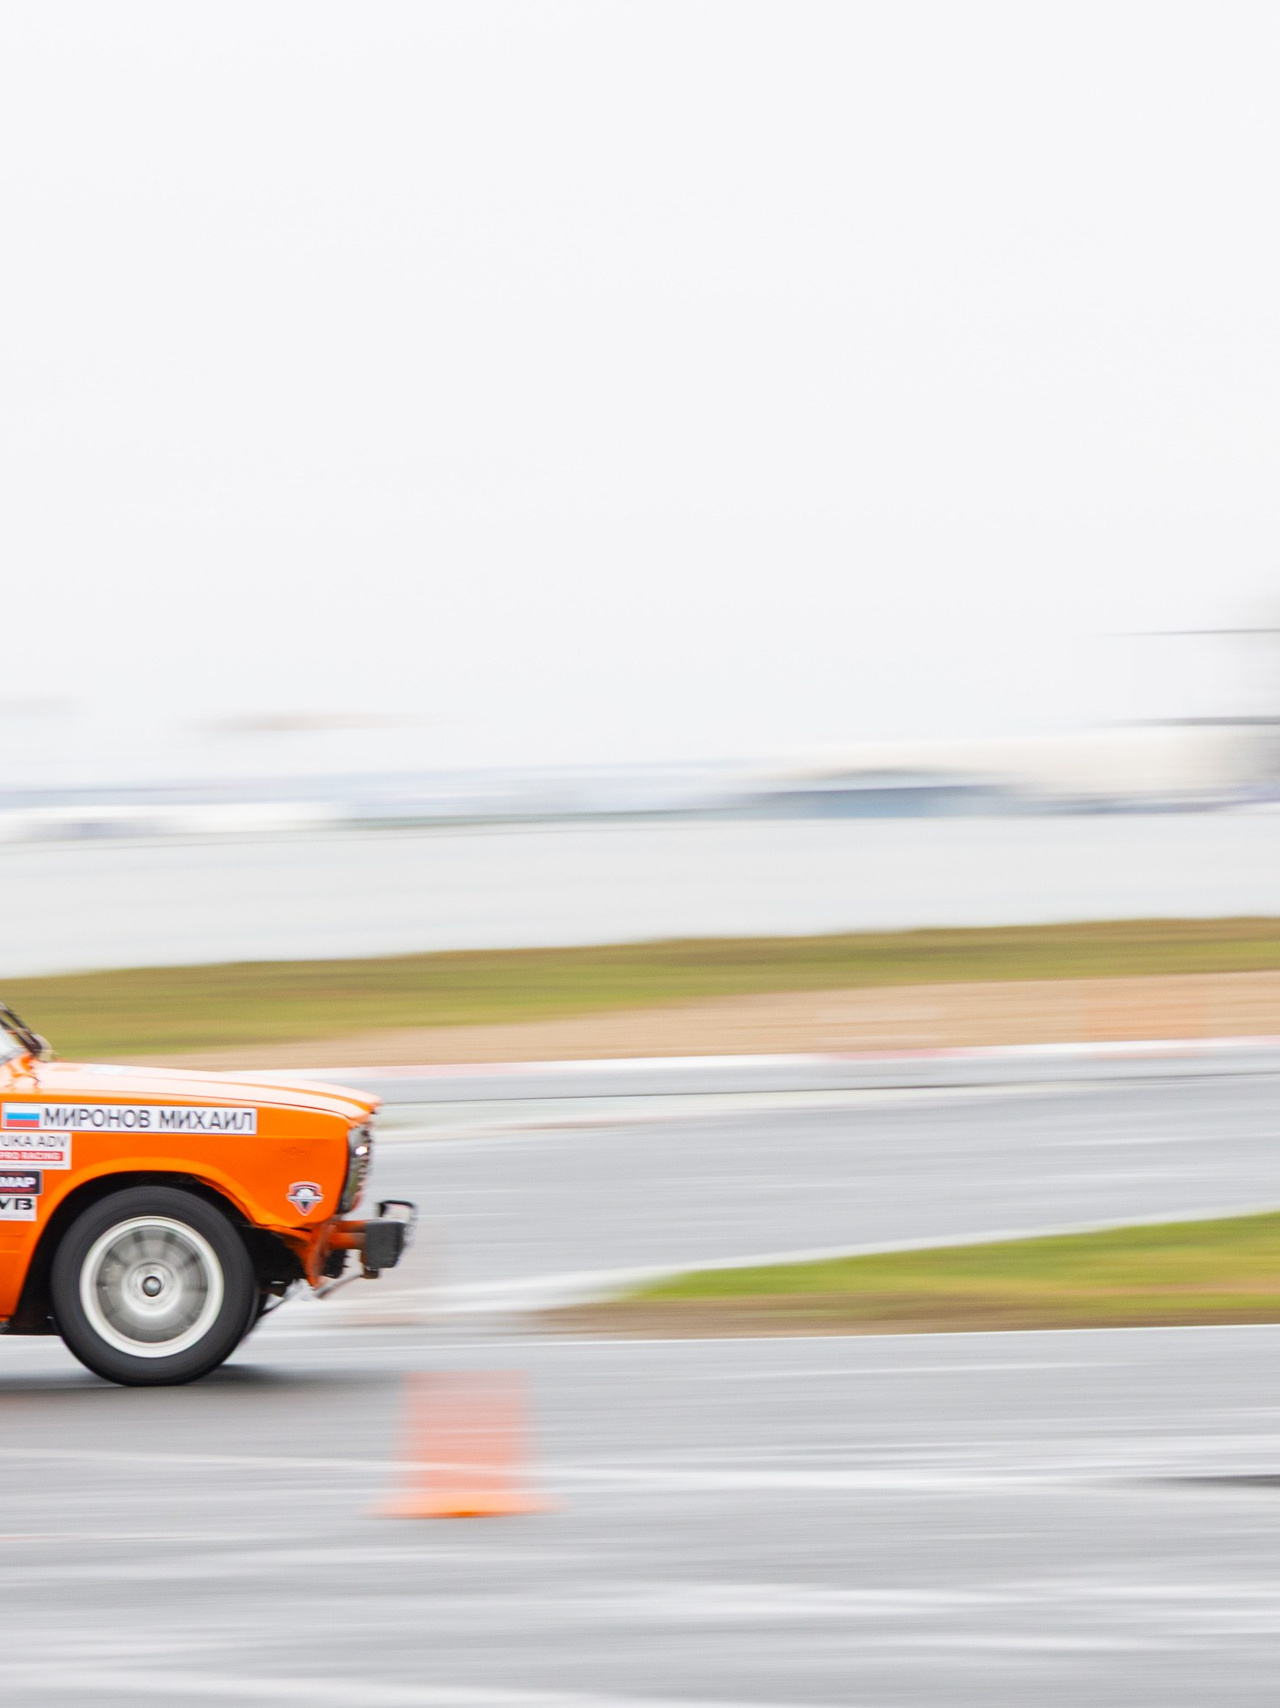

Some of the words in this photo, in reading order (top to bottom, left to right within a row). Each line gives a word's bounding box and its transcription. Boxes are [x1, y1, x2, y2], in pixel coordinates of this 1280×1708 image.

[43, 1107, 150, 1129] МИРОНОВ
[159, 1110, 254, 1131] МИХАИЛ
[38, 1135, 68, 1147] ADV
[22, 1151, 61, 1160] RACING
